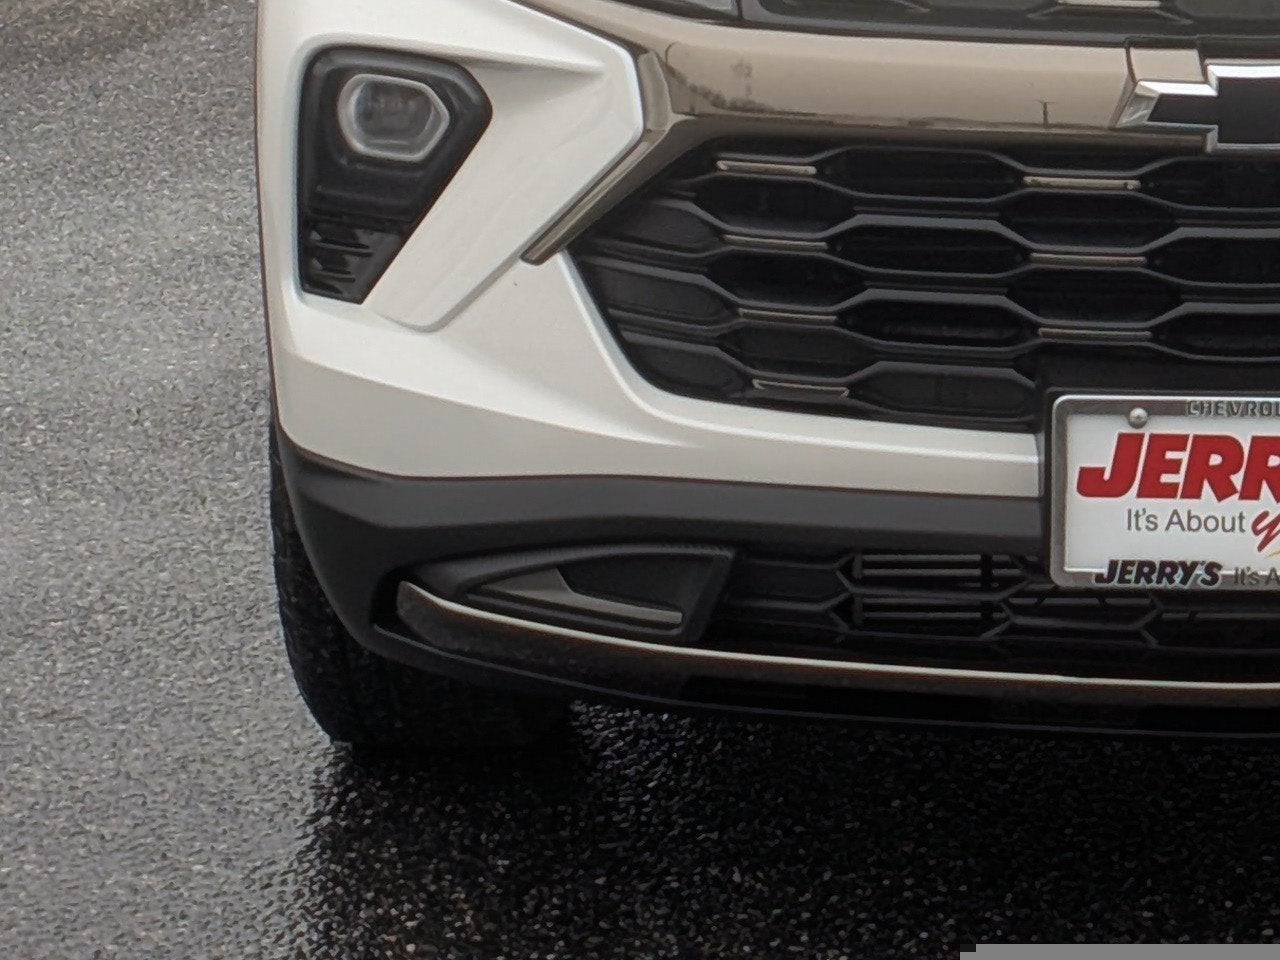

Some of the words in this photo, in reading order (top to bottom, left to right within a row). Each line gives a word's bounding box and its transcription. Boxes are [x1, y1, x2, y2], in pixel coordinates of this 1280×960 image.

[1127, 509, 1158, 532] It's
[1166, 508, 1246, 533] About
[1094, 558, 1223, 587] JERRY'S
[1234, 567, 1259, 586] It's
